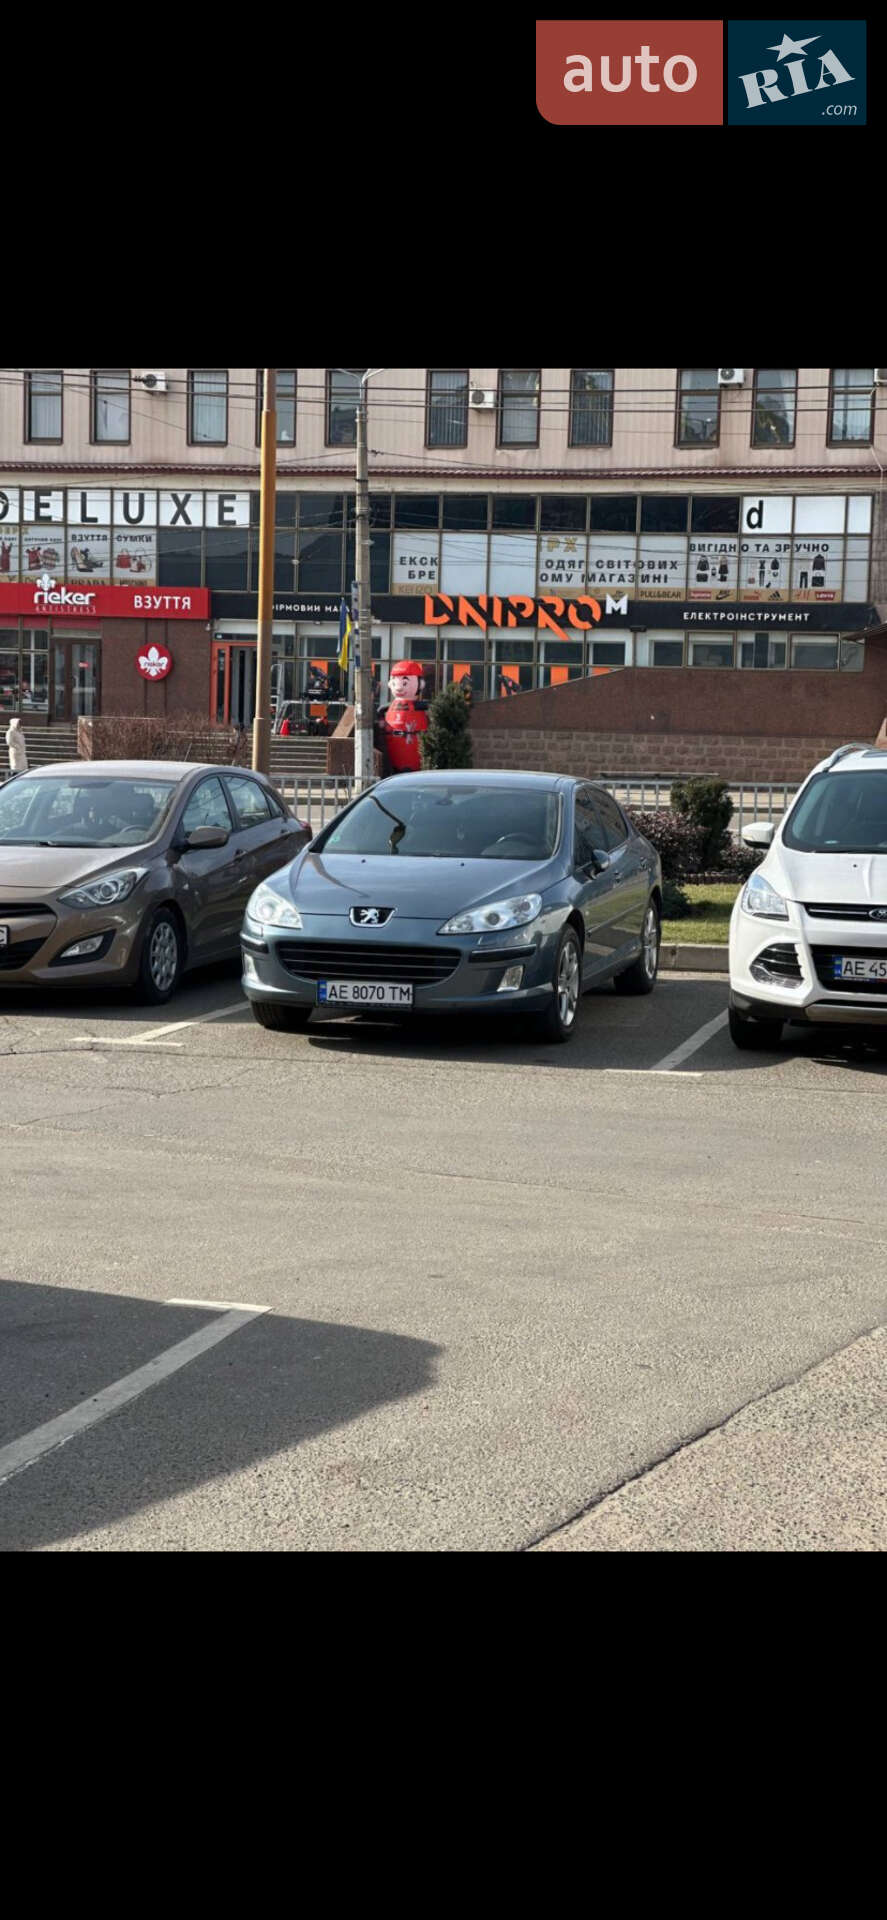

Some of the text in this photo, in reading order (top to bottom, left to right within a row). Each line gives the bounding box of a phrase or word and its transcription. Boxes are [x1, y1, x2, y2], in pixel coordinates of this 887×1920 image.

[746, 500, 764, 529] d
[689, 543, 830, 553] ВИГІДНО ТА ЗРУЧНО
[399, 556, 438, 566] ЕКСК
[545, 559, 679, 571] ОДЯГ СВІТОВИХ
[408, 570, 436, 580] БРЕ
[540, 573, 668, 584] ОМУ МАГАЗИНІ
[34, 587, 96, 605] rieker
[134, 595, 191, 610] ВЗУТТЯ
[424, 593, 628, 641] DNIPRO M
[683, 612, 810, 622] ЕЛЕКТРОІНСТРУМЕНТ
[843, 960, 887, 977] AE 45
[328, 985, 411, 1001] AE 8070 TM
